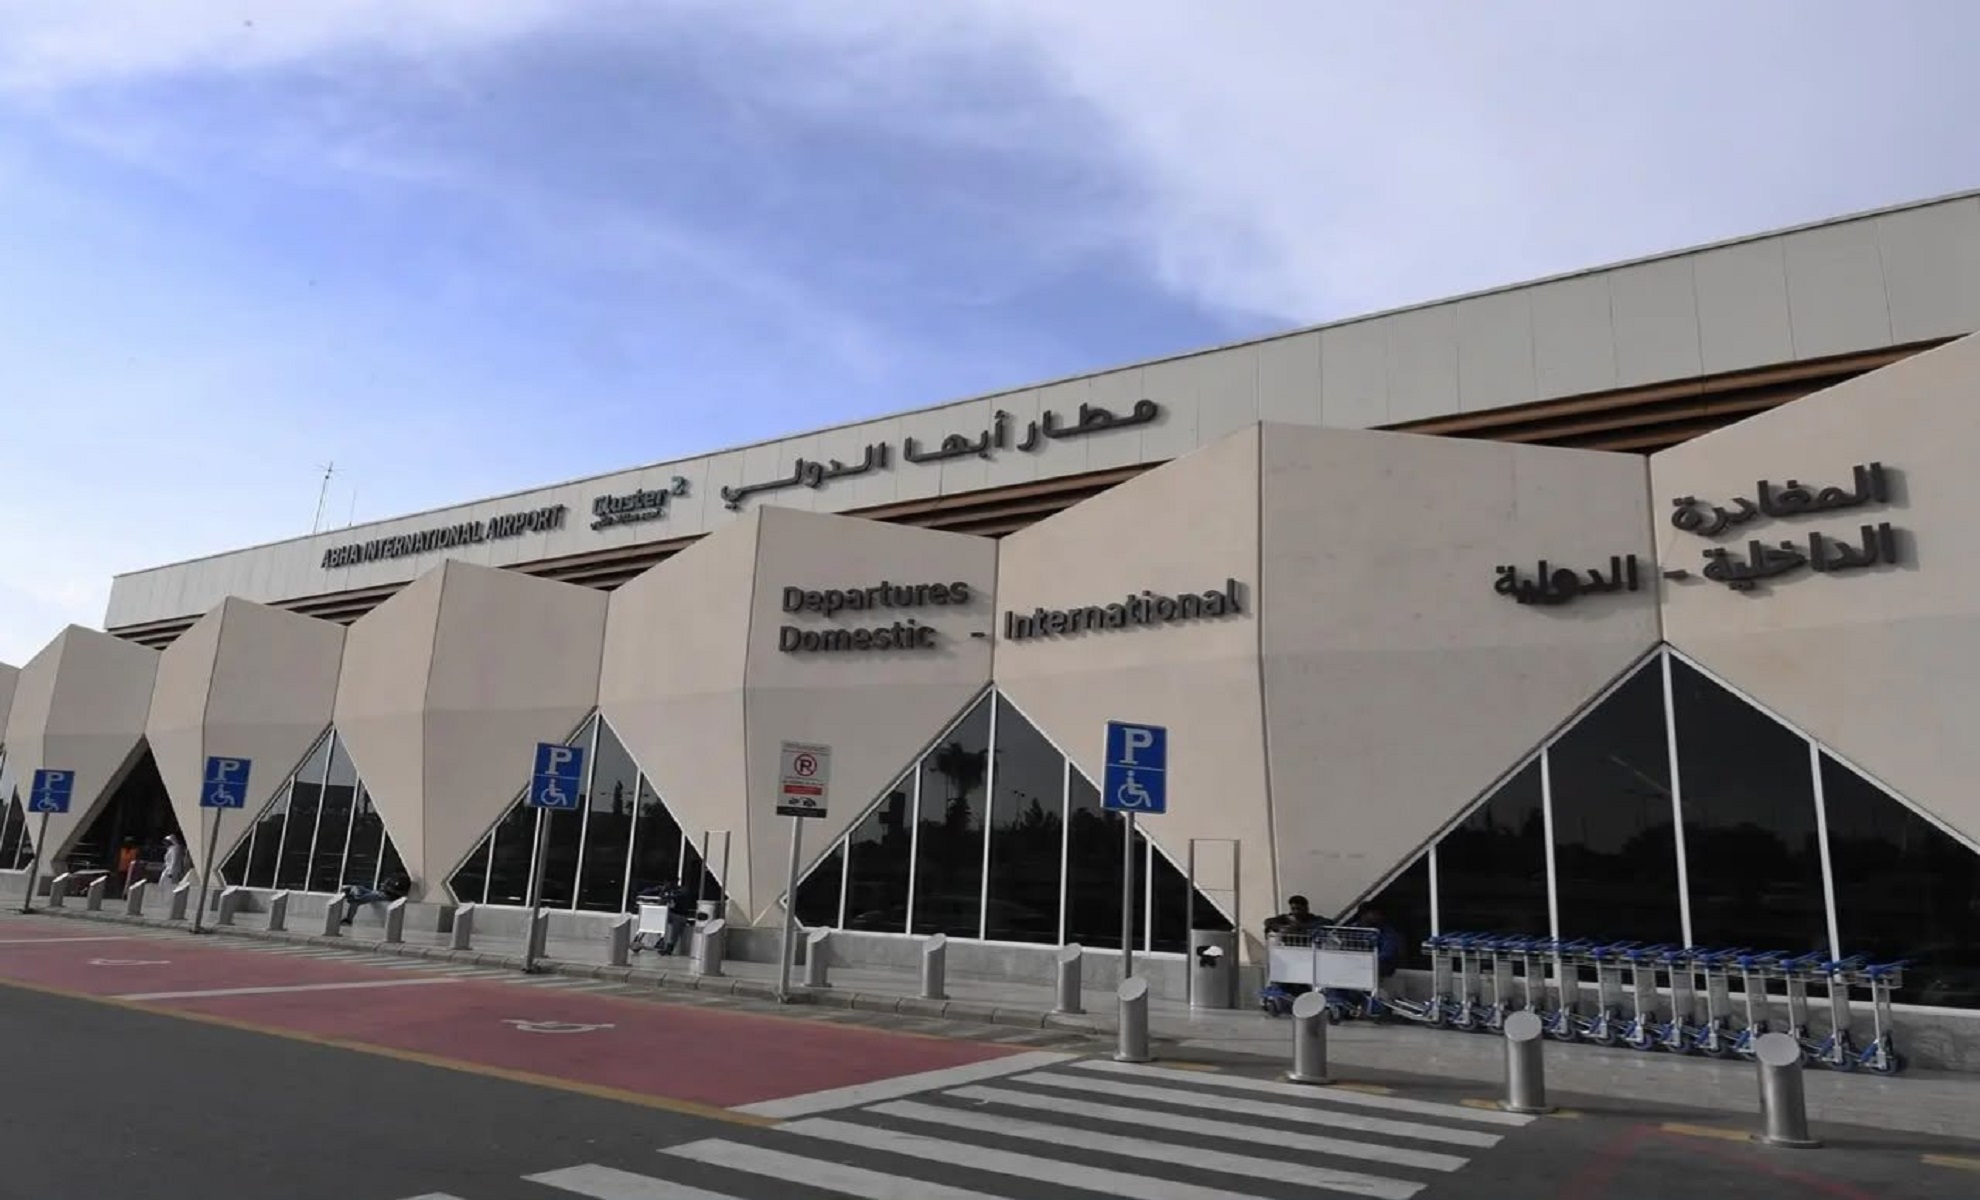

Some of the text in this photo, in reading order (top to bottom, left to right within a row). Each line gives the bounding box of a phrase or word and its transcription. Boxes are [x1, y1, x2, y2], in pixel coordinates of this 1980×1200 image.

[720, 399, 1160, 511] مطار أبها الدولي
[592, 488, 668, 516] Cluster
[1671, 461, 1885, 537] المغادرة
[321, 543, 363, 568] ABHA
[364, 520, 483, 561] INTERNATIONAL
[486, 504, 565, 540] AIRPORT
[1702, 522, 1897, 591] الداخلية
[782, 580, 969, 618] Departures
[1494, 553, 1638, 604] الدولية
[779, 619, 936, 652] Domestic
[1004, 577, 1242, 640] International
[544, 747, 573, 775] P
[1118, 727, 1154, 765] P
[40, 772, 64, 791] P
[213, 760, 240, 782] P
